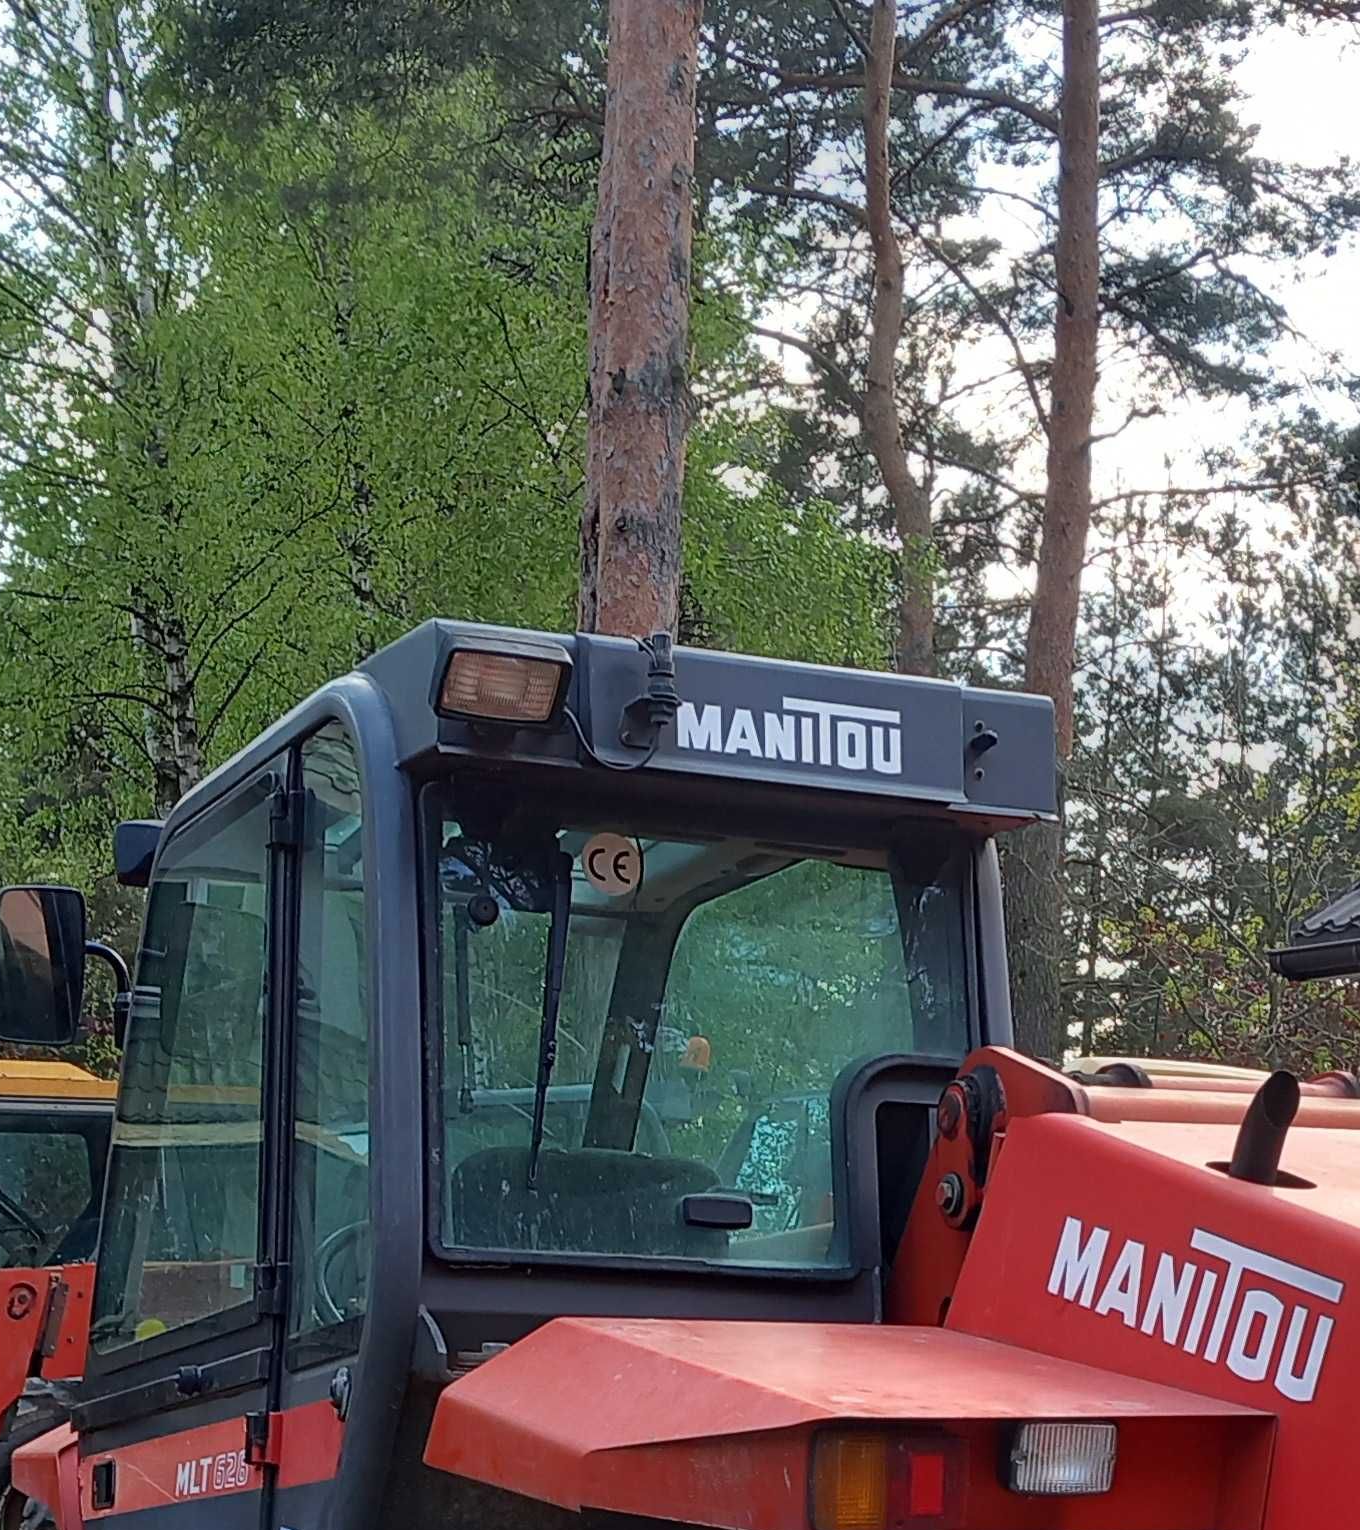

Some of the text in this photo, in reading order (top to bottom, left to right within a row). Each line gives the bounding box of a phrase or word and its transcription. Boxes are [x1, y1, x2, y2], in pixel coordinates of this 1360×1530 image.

[676, 696, 902, 775] MANITOU
[588, 847, 631, 885] CE
[1047, 1216, 1344, 1402] MANITOU
[175, 1456, 213, 1497] MLT
